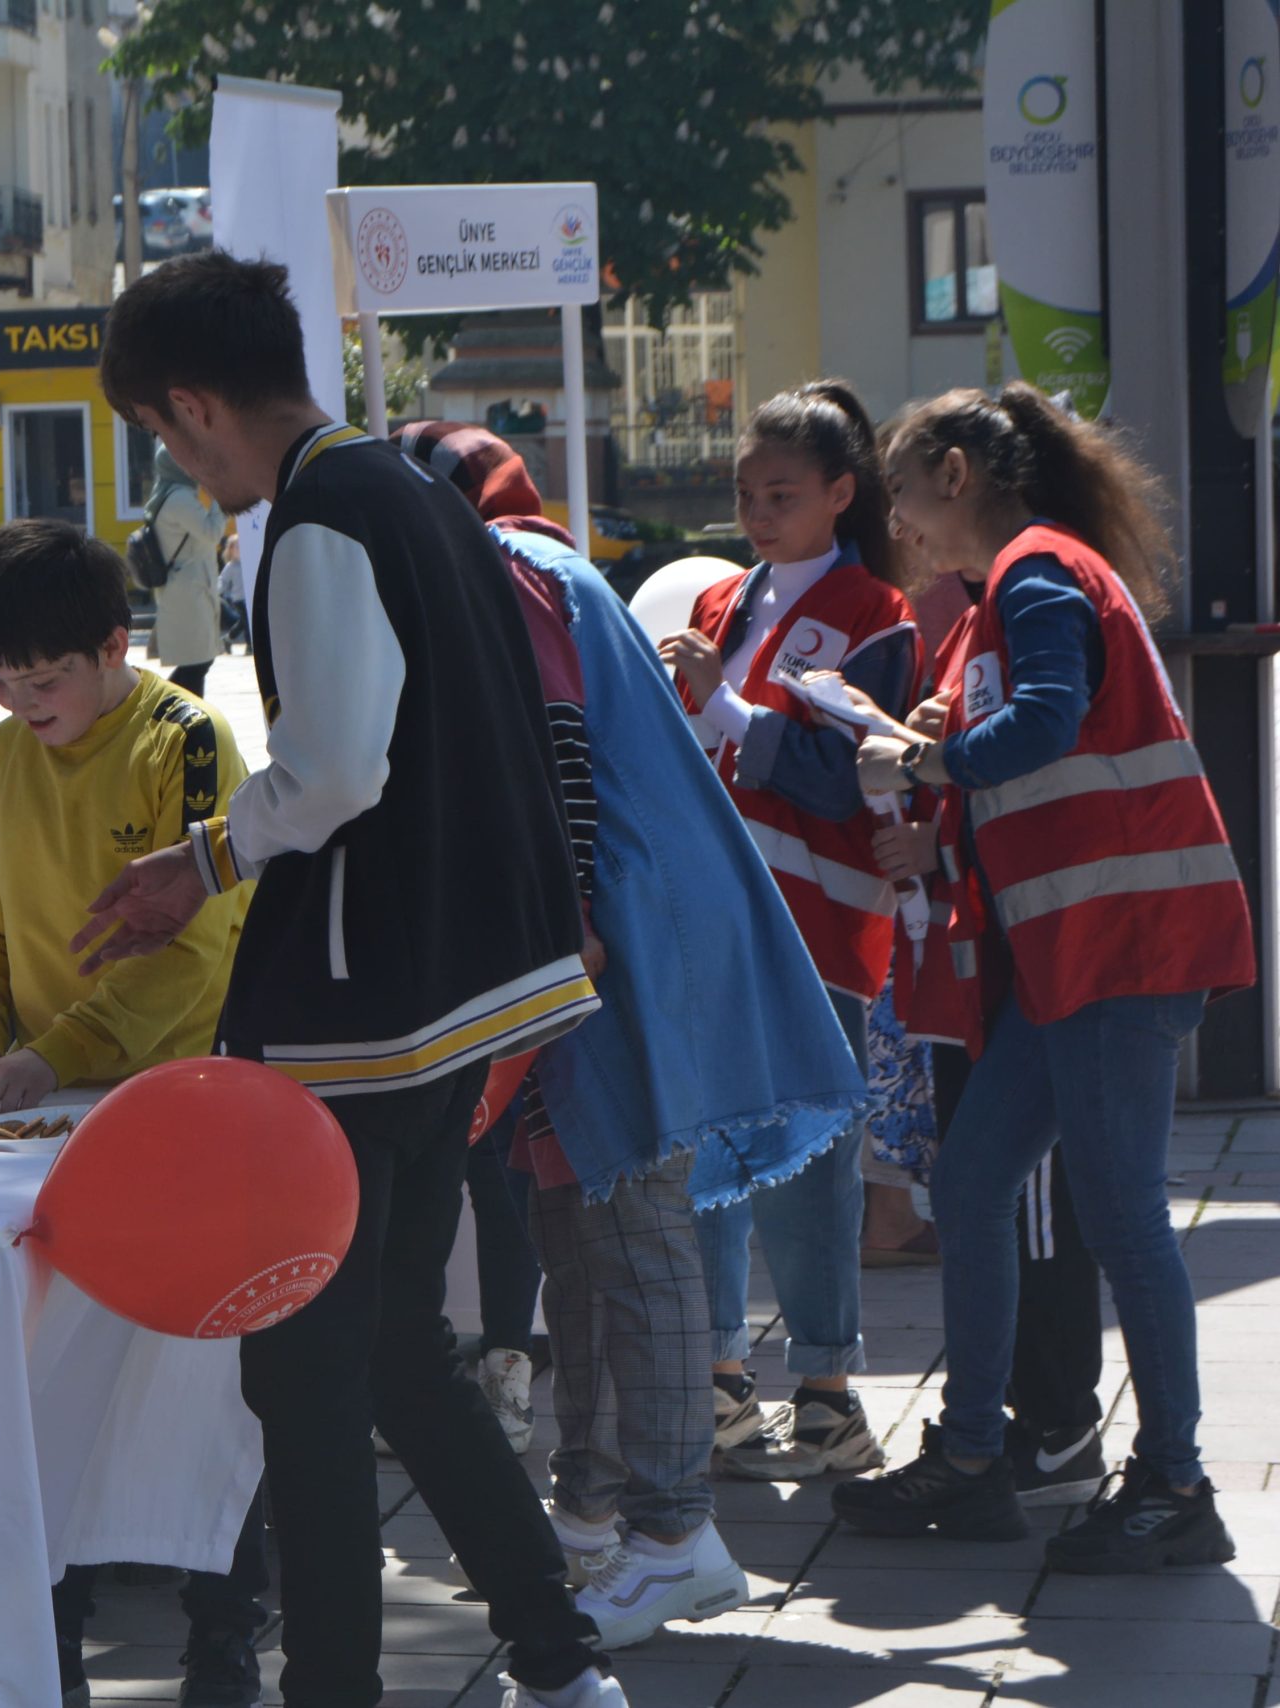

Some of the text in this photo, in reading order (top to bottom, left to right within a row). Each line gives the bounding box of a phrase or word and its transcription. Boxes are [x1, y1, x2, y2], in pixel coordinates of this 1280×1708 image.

[459, 218, 495, 243] ÜNYE
[417, 249, 476, 278] GENÇLİK
[481, 246, 540, 272] MERKEZİ
[5, 324, 99, 352] TAKSİ
[114, 845, 144, 854] adidas
